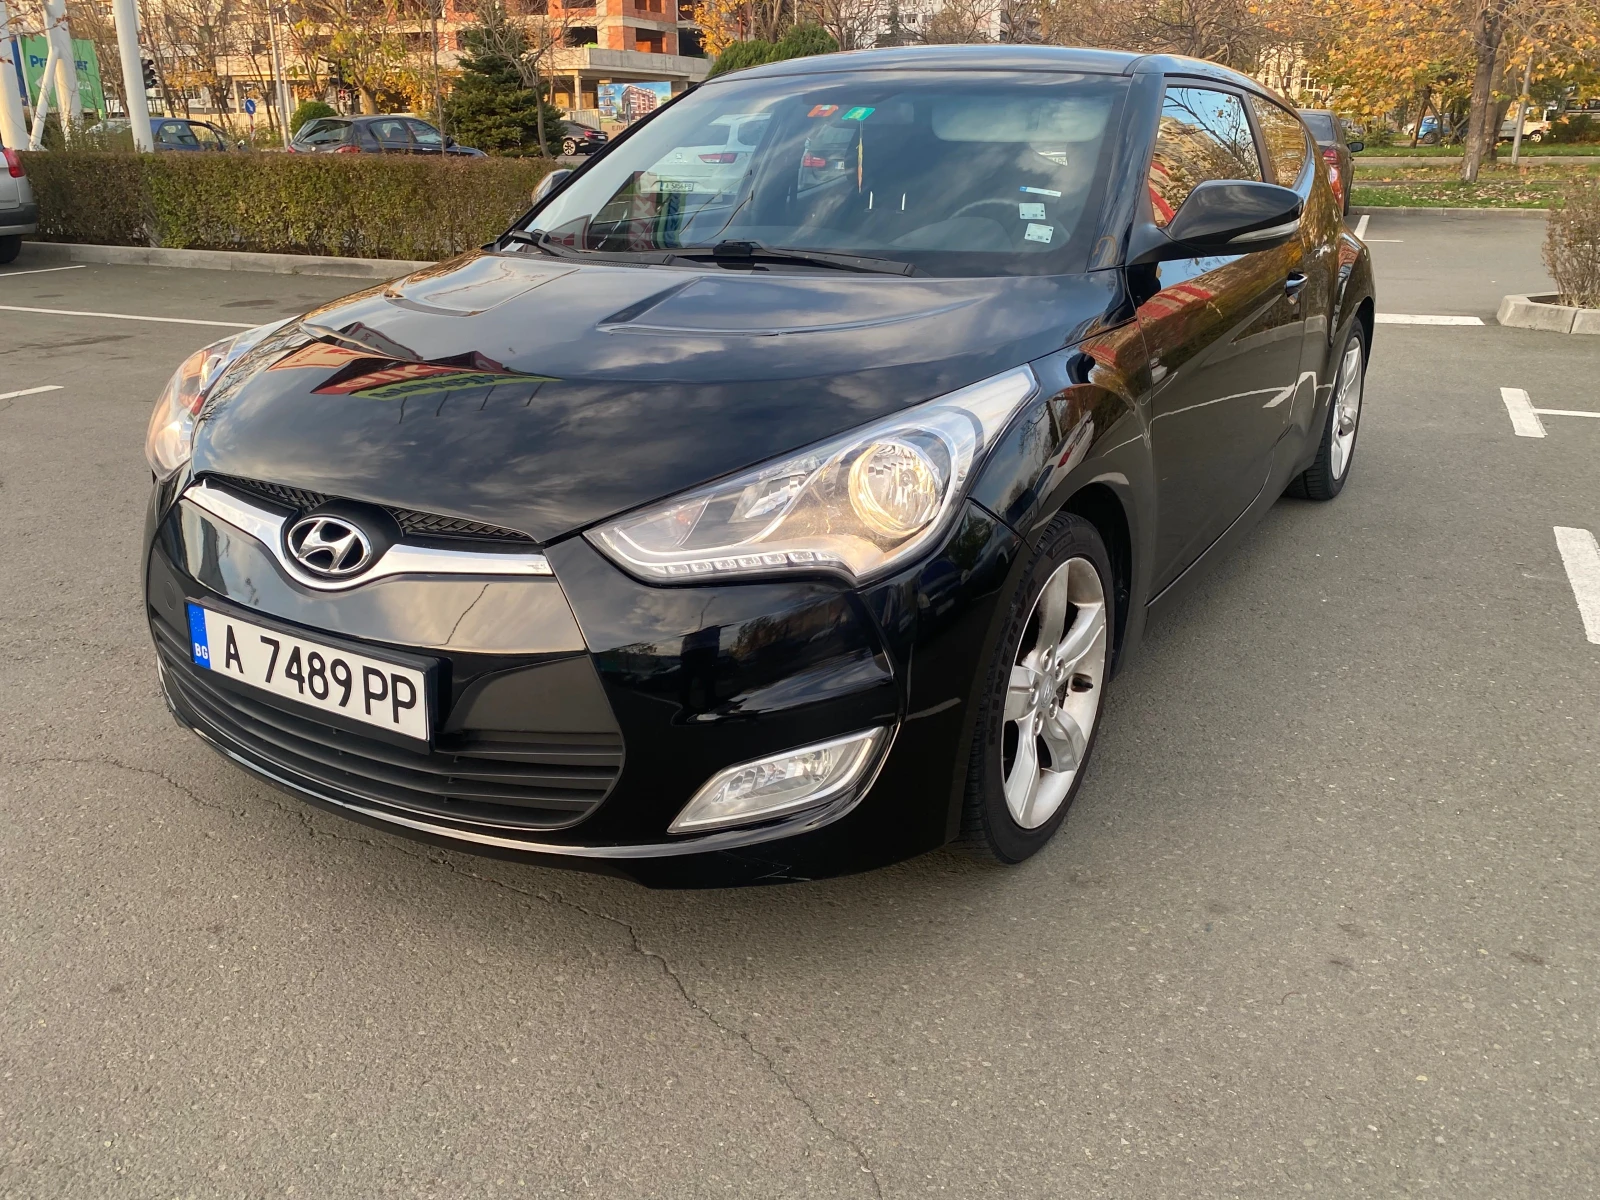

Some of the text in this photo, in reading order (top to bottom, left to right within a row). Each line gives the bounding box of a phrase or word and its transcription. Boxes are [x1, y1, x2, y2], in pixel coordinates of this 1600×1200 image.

[194, 642, 209, 660] BG
[225, 624, 417, 724] A 7489 PP
[988, 577, 1037, 748] MINERVA
